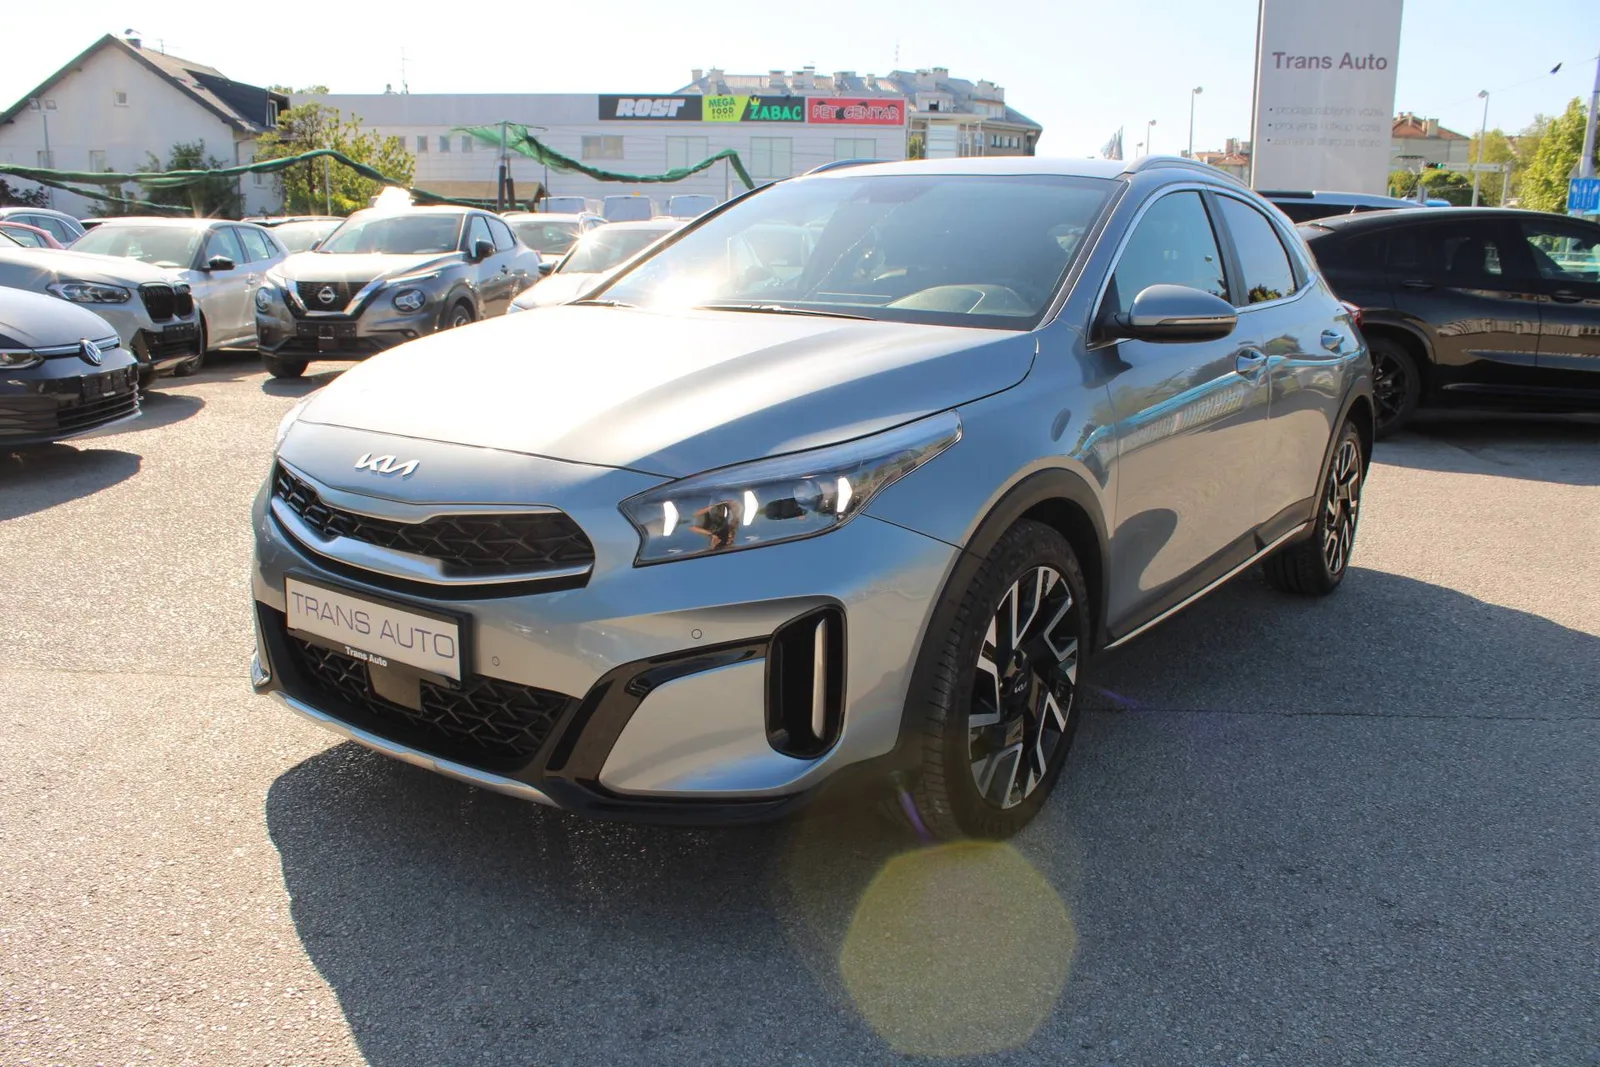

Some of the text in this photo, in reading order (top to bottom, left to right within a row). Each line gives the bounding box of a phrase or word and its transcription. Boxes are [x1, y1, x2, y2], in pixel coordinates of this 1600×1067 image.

[1272, 52, 1388, 70] Trans Auto
[708, 97, 736, 108] MEGA
[712, 106, 733, 115] FOOD
[813, 105, 899, 120] PET CENTAR
[291, 591, 455, 659] TRANS AUTO
[345, 646, 387, 667] Trans Auto
